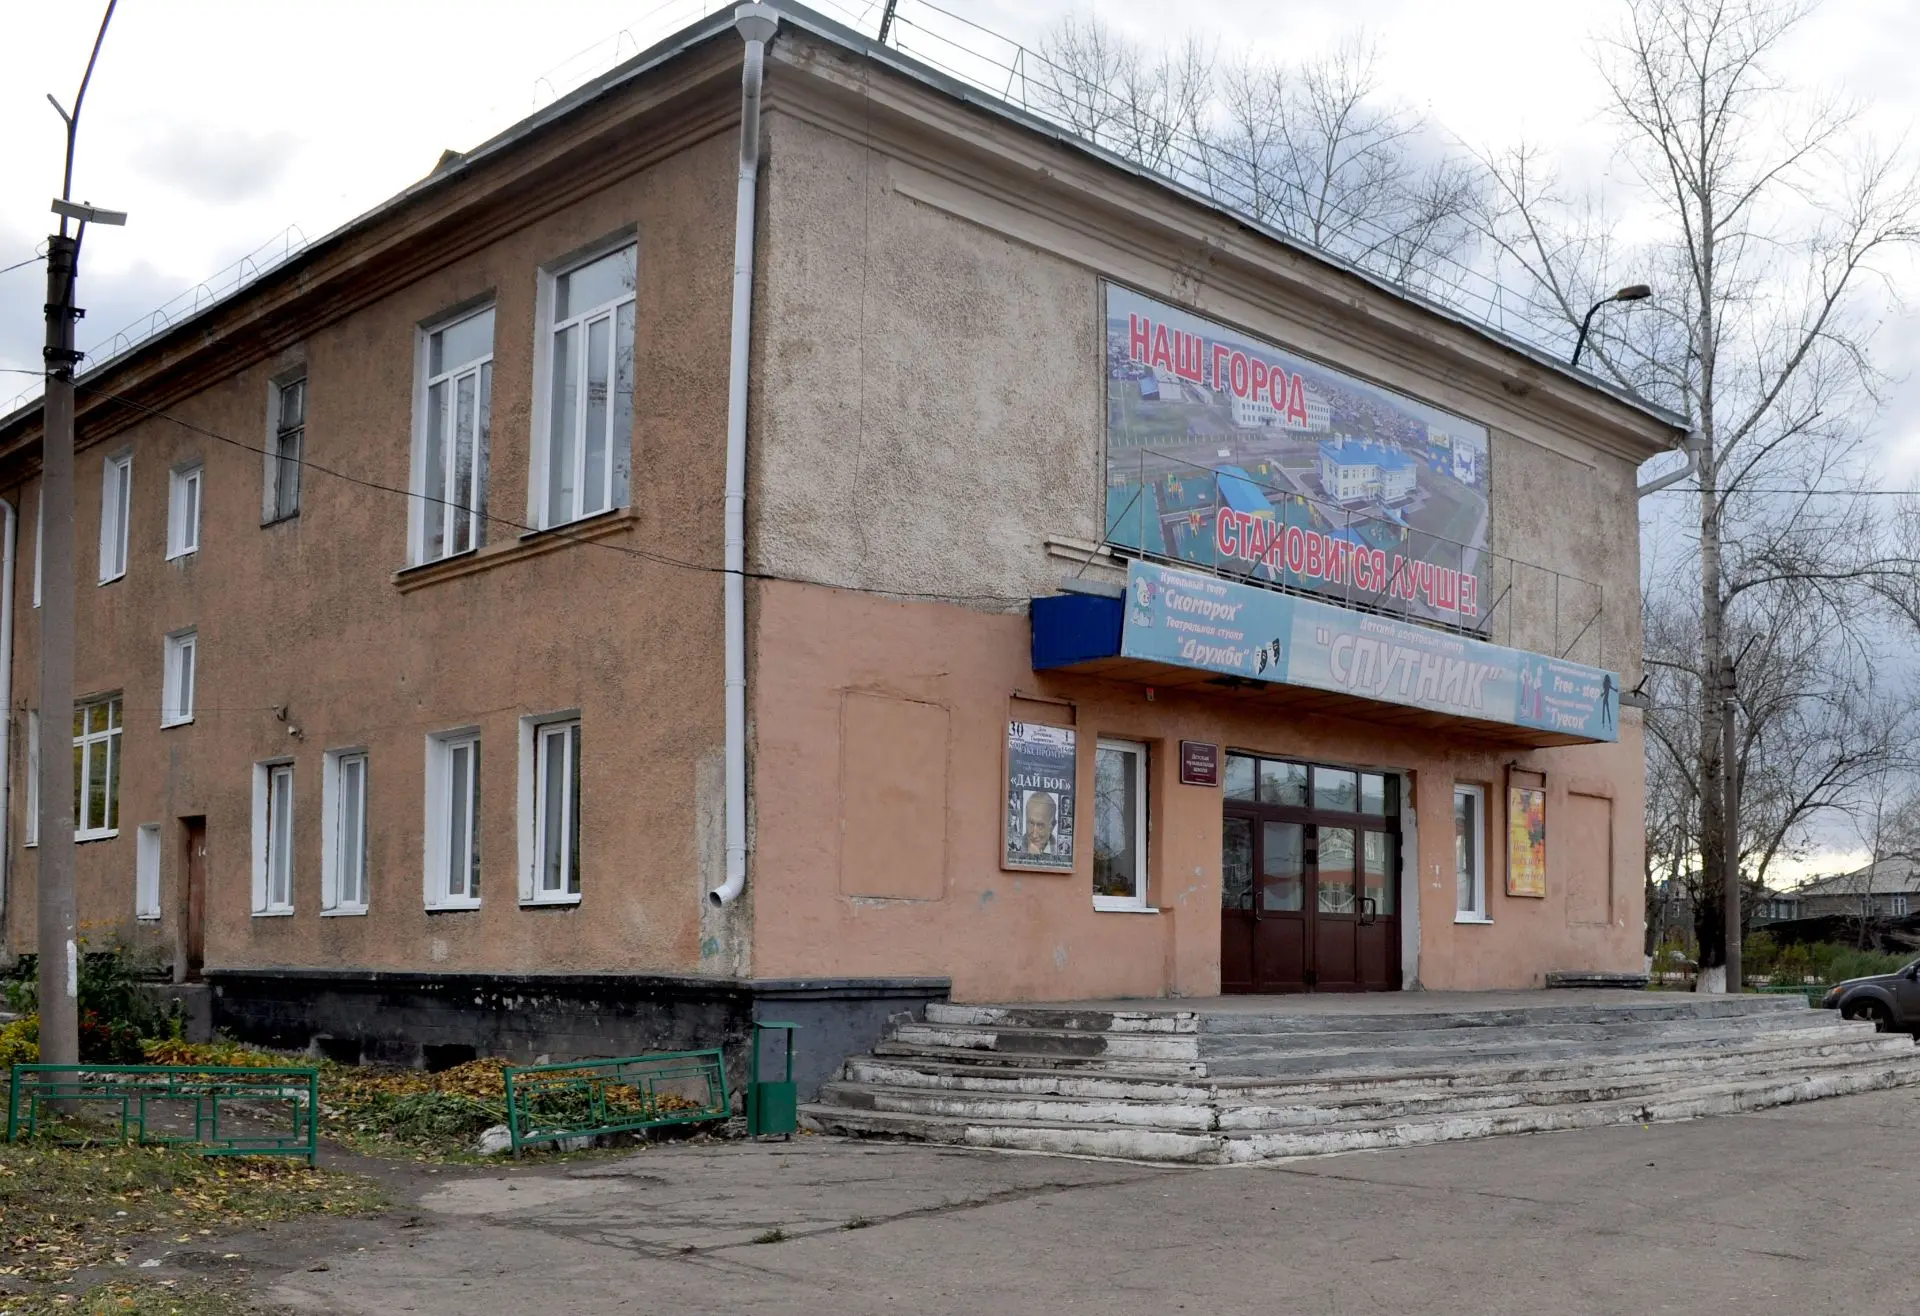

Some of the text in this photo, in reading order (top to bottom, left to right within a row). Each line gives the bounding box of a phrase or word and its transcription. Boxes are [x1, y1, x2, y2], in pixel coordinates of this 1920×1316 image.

[1128, 312, 1308, 427] НАШ ГОРОД
[1216, 506, 1479, 617] СТАНОВИТСЯ ЛУЧШЕ!
[1165, 616, 1217, 635] Театральная
[1178, 636, 1250, 668] "Дружба"
[1316, 627, 1500, 710] "СПУТНИК"
[1008, 720, 1024, 738] 30
[1010, 772, 1071, 790] «ДАЙ БОГ»
